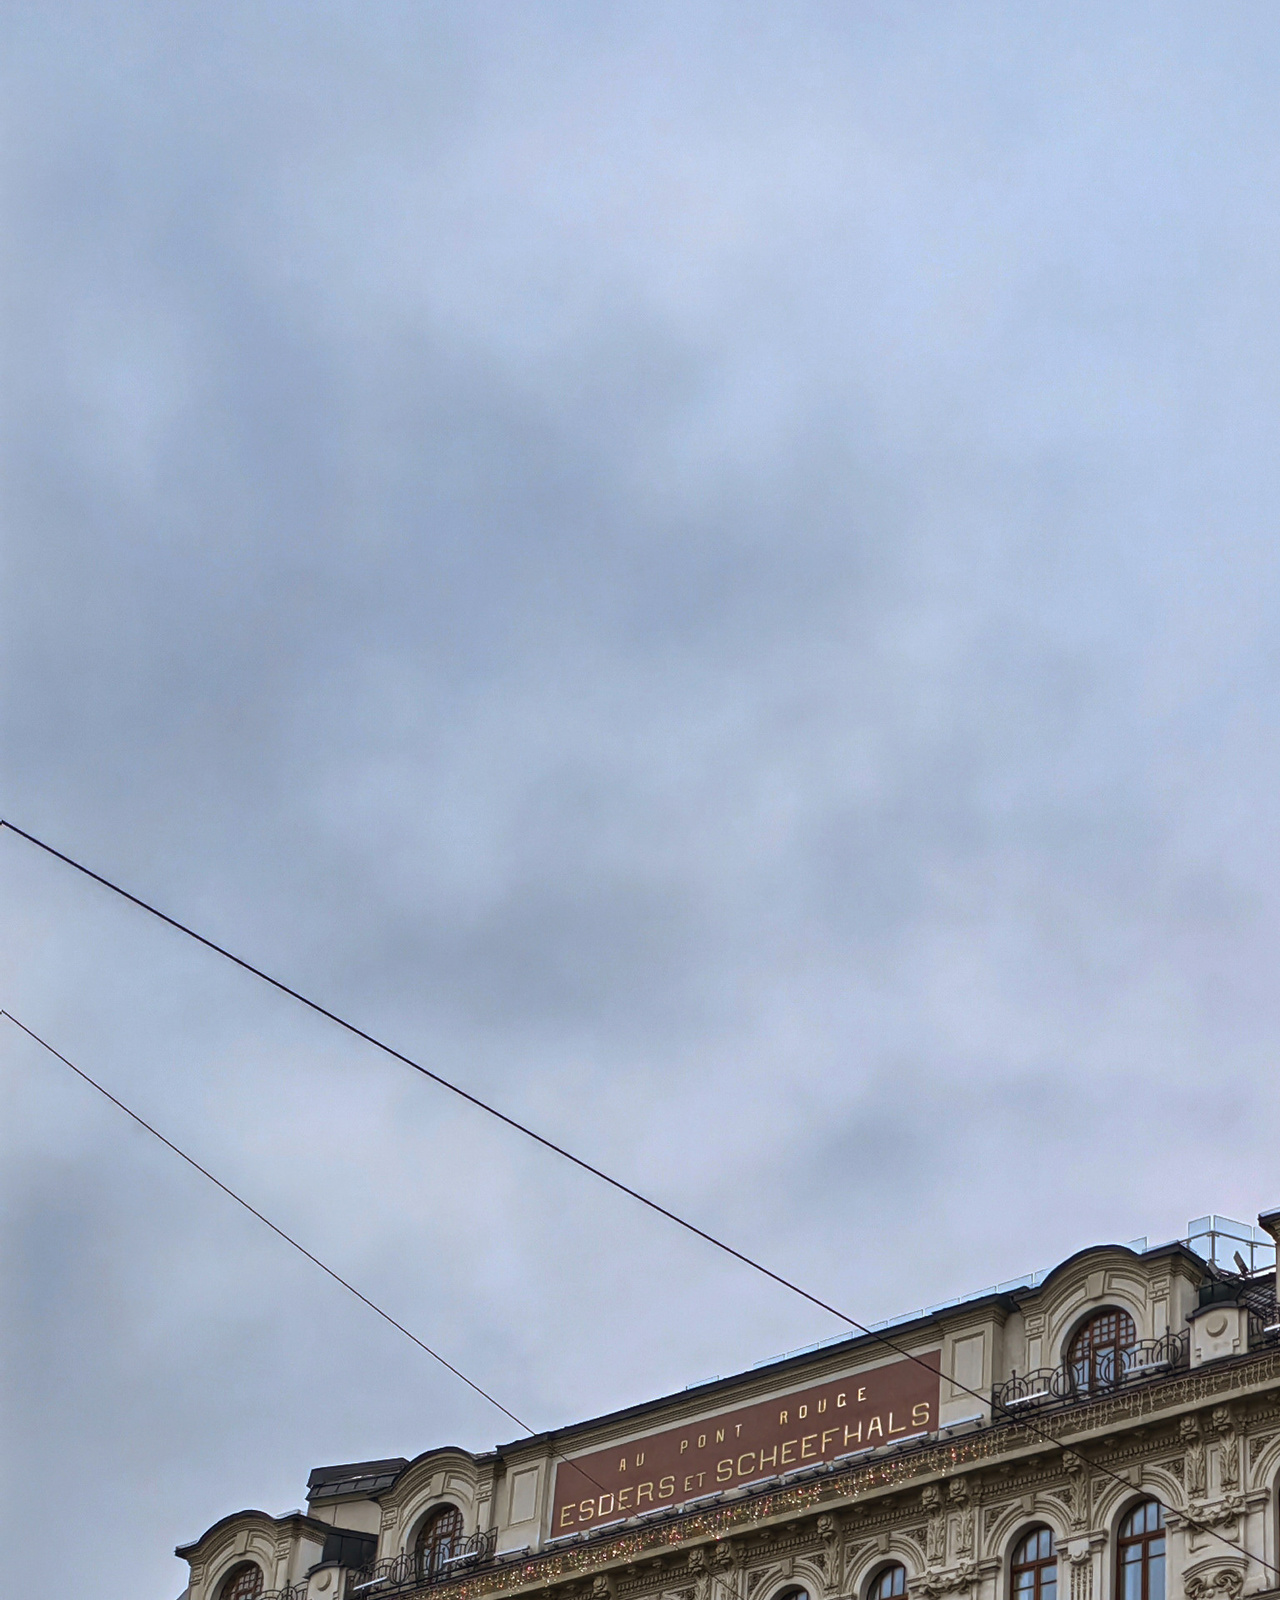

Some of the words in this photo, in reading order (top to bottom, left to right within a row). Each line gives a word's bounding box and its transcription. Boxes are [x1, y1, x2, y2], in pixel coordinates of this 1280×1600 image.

[559, 1475, 675, 1528] ESDERS
[684, 1472, 706, 1492] ET
[716, 1402, 931, 1483] SCHEEFHALS
[619, 1453, 646, 1472] AU
[680, 1424, 743, 1454] PONT
[780, 1387, 867, 1424] ROUGE
